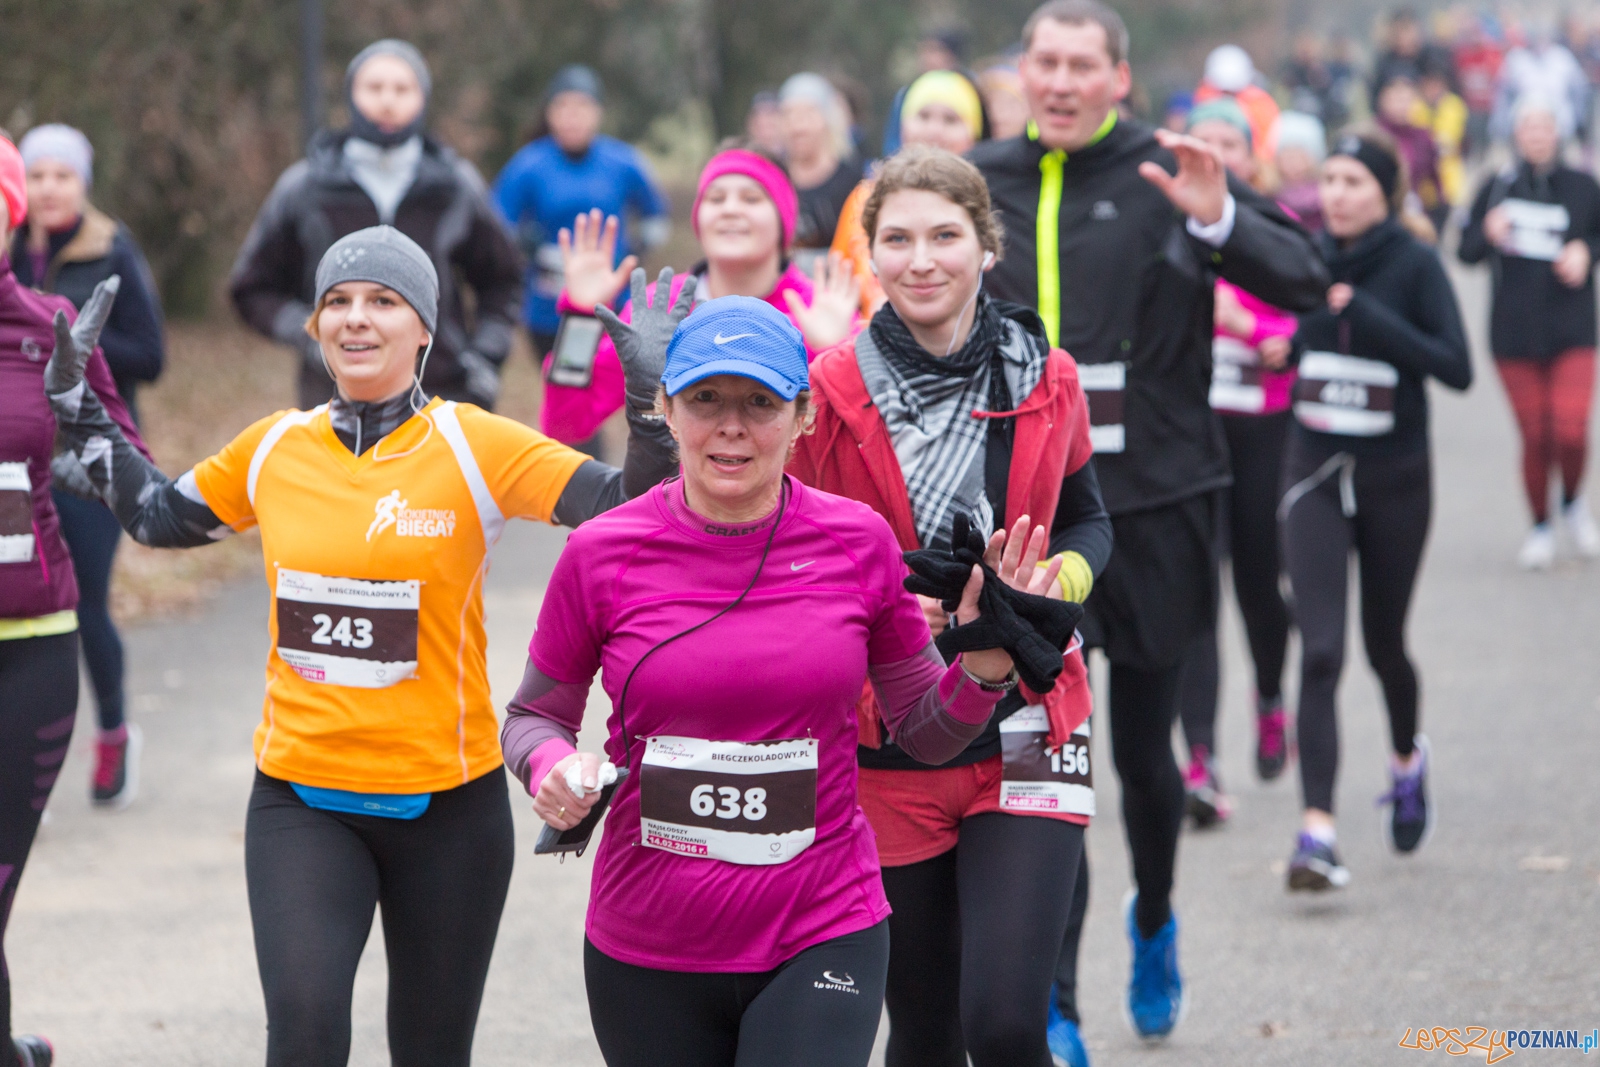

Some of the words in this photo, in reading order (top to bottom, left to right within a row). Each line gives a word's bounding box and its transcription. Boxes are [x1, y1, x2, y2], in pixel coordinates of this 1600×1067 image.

[397, 508, 456, 521] ROKIETNICA
[704, 524, 759, 537] CRAFT
[327, 586, 412, 599] BIEGCZEKOLADOWY.PL
[311, 613, 374, 649] 243
[711, 750, 810, 763] BIEGCZEKOLADOWY.PL
[1043, 743, 1090, 776] 156
[689, 783, 768, 821] 638
[647, 823, 688, 835] NAJSŁODSZY
[648, 829, 662, 837] BIEG
[671, 834, 707, 845] POZNANIU
[649, 836, 697, 853] 14.02.2016
